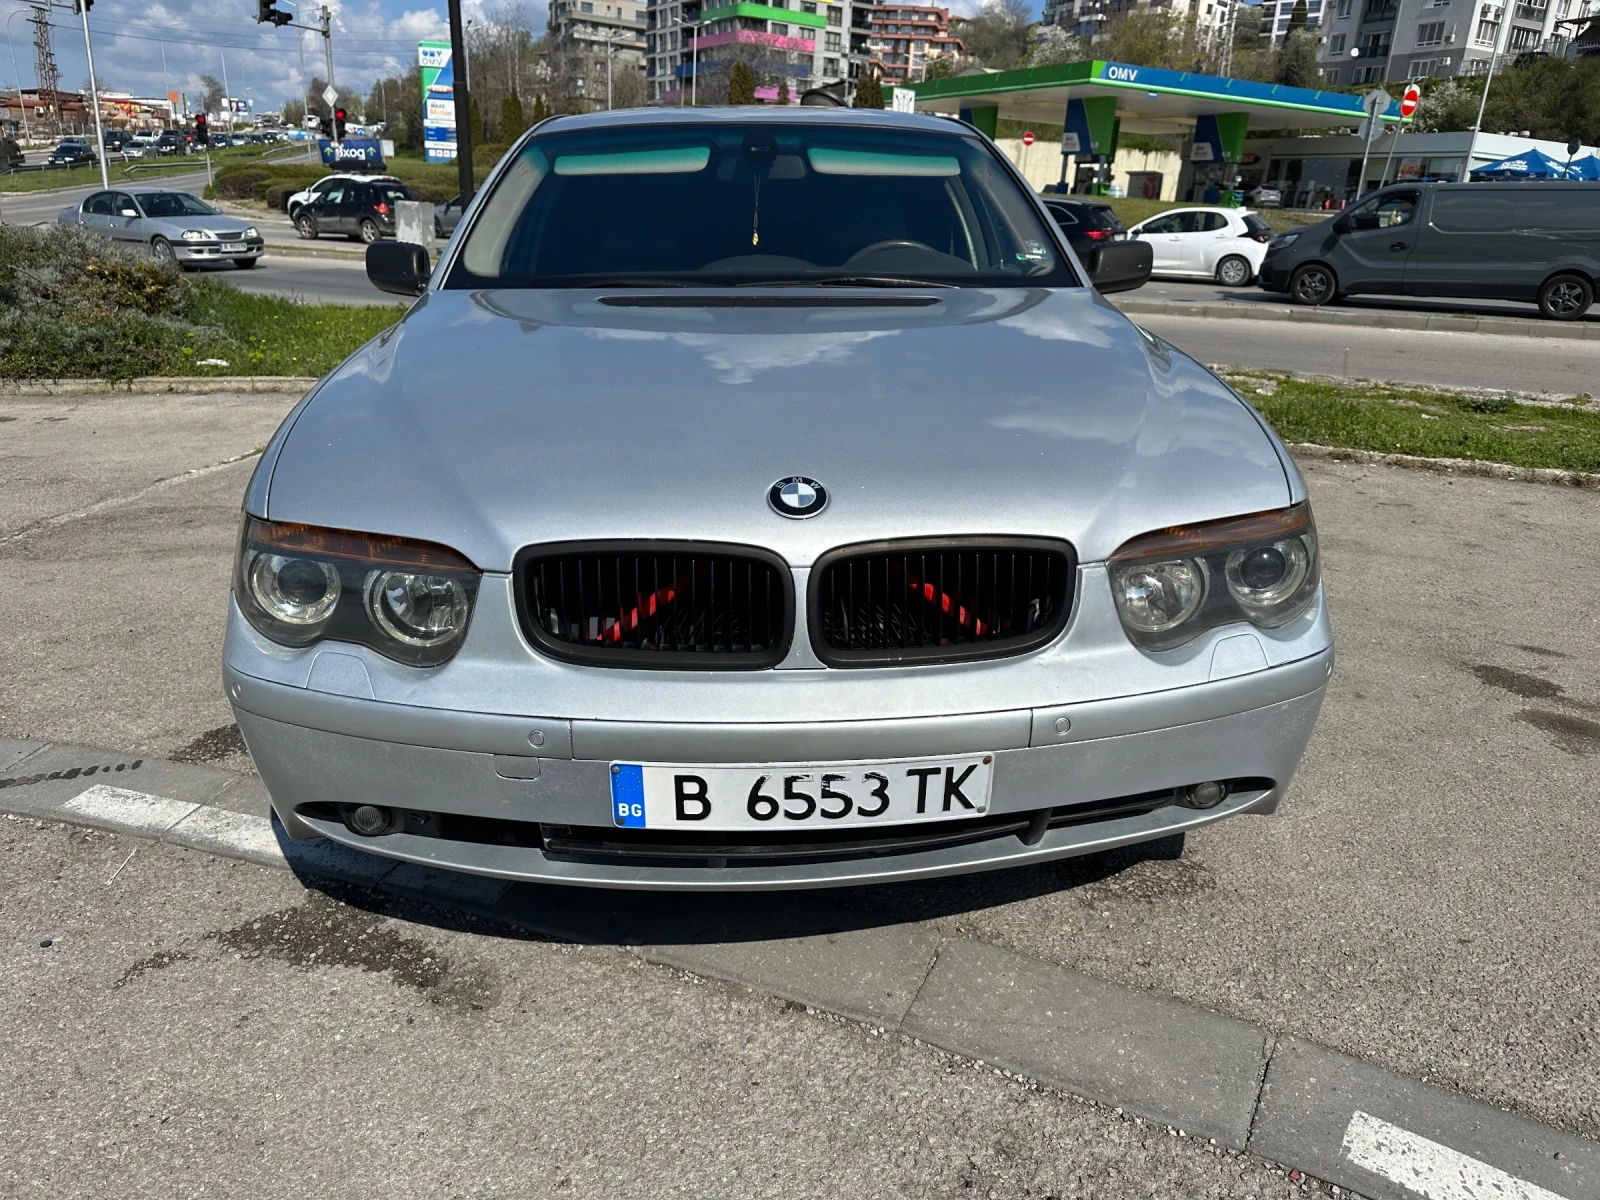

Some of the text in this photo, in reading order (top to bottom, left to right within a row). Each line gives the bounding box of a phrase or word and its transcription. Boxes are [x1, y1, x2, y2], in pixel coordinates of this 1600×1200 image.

[1108, 66, 1138, 81] OMV
[775, 477, 821, 489] BMW
[674, 764, 979, 820] B 6553 TK
[618, 803, 643, 817] BG
